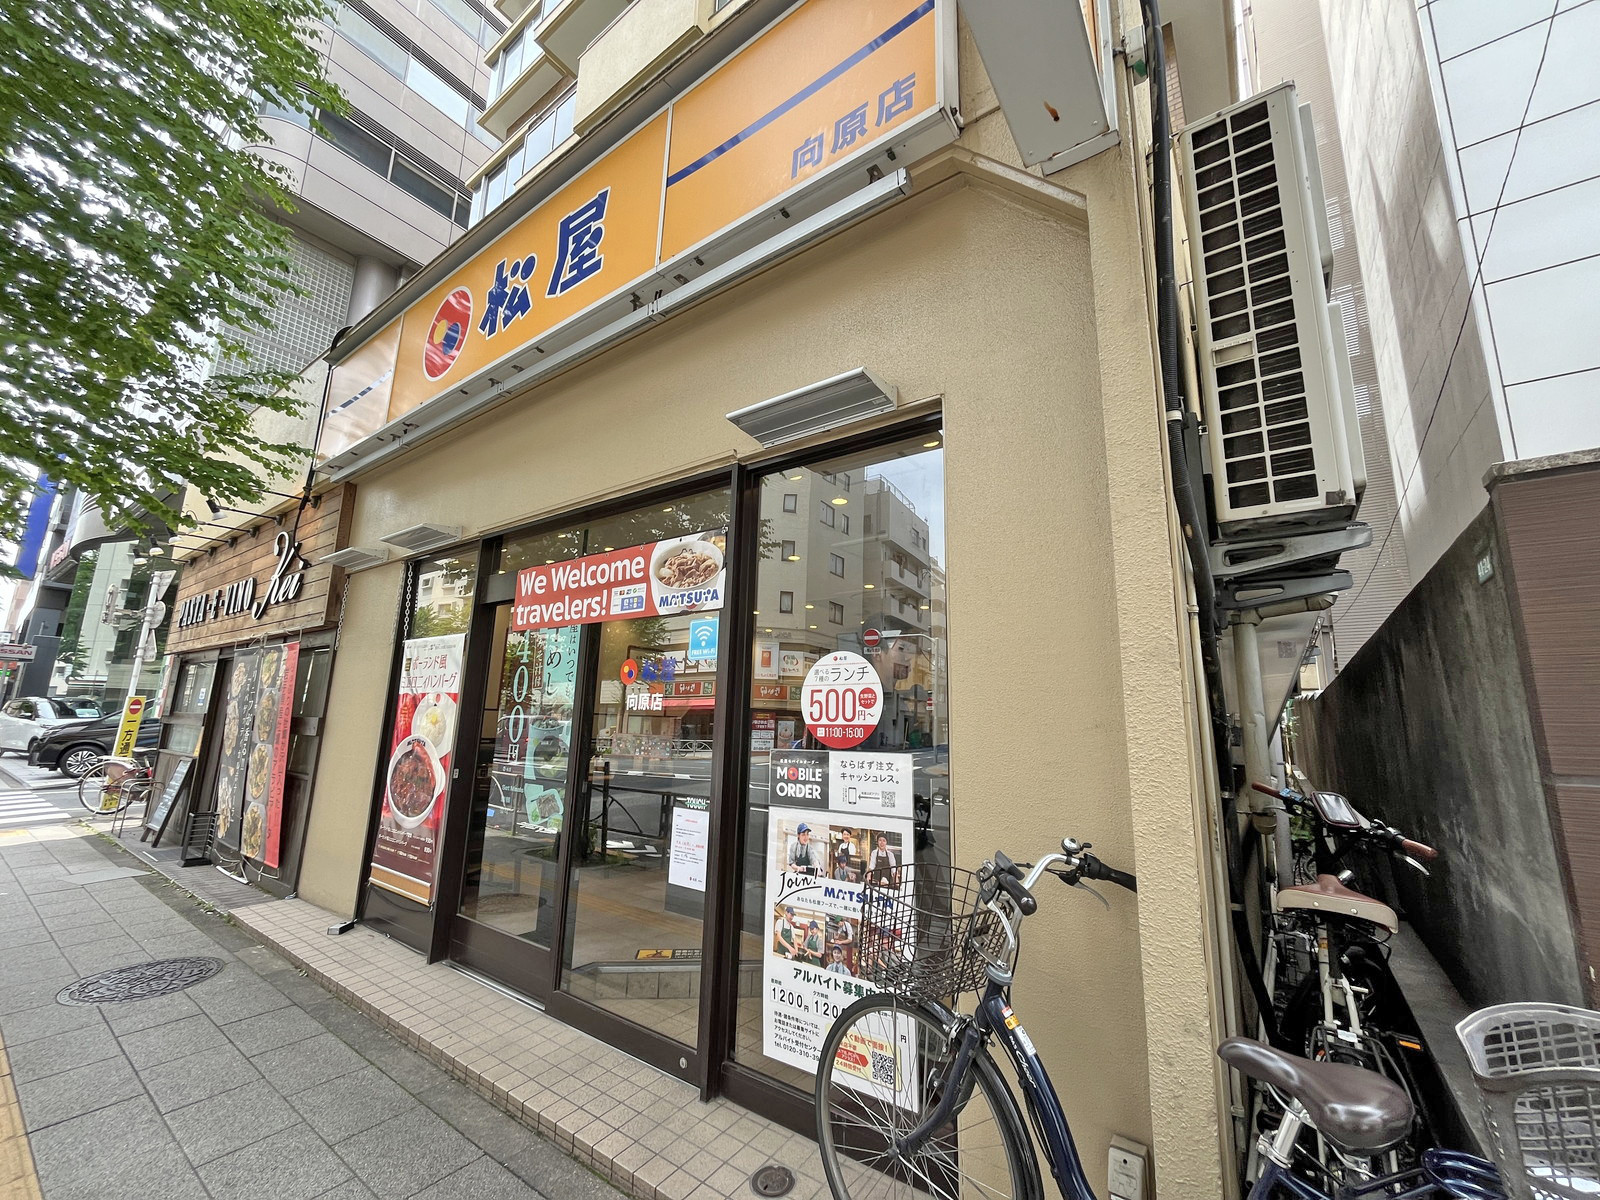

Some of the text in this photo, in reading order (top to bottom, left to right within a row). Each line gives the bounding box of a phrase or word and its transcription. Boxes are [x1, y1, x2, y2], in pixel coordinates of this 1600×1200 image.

[791, 72, 916, 180] 向原店
[478, 186, 611, 340] 松屋
[520, 556, 645, 597] We Welcome
[659, 589, 719, 608] MATSUYA
[516, 590, 608, 626] travelers!
[413, 654, 448, 670] ポーランド風
[830, 665, 869, 682] ランチ
[626, 693, 664, 711] 向原店
[118, 720, 137, 758] 一方通
[825, 727, 864, 738] 11:00-15:00
[776, 765, 823, 782] MOBILE
[840, 760, 900, 772] ならばず注文。
[840, 772, 900, 785] キャッシュレス。
[776, 782, 821, 799] ORDER
[778, 868, 818, 897] Join!
[900, 1035, 907, 1043] 円
